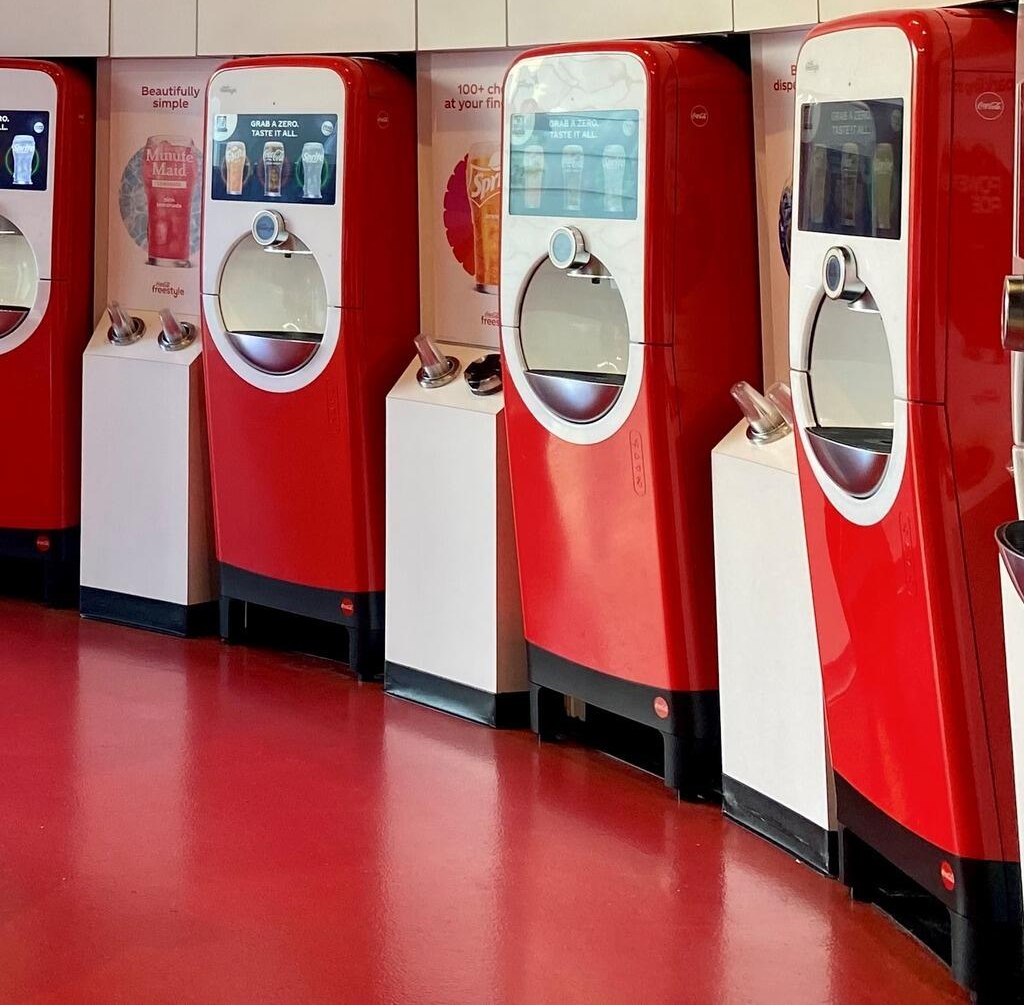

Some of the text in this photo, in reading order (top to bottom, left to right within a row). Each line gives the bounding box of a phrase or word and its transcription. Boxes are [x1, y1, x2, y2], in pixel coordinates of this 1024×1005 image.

[141, 86, 200, 98] Beautifully
[457, 83, 502, 95] 100+ ch
[152, 98, 189, 110] simple
[444, 97, 502, 111] at your fin
[146, 146, 194, 163] Minute
[152, 162, 187, 177] Maid
[152, 284, 185, 298] freestyle
